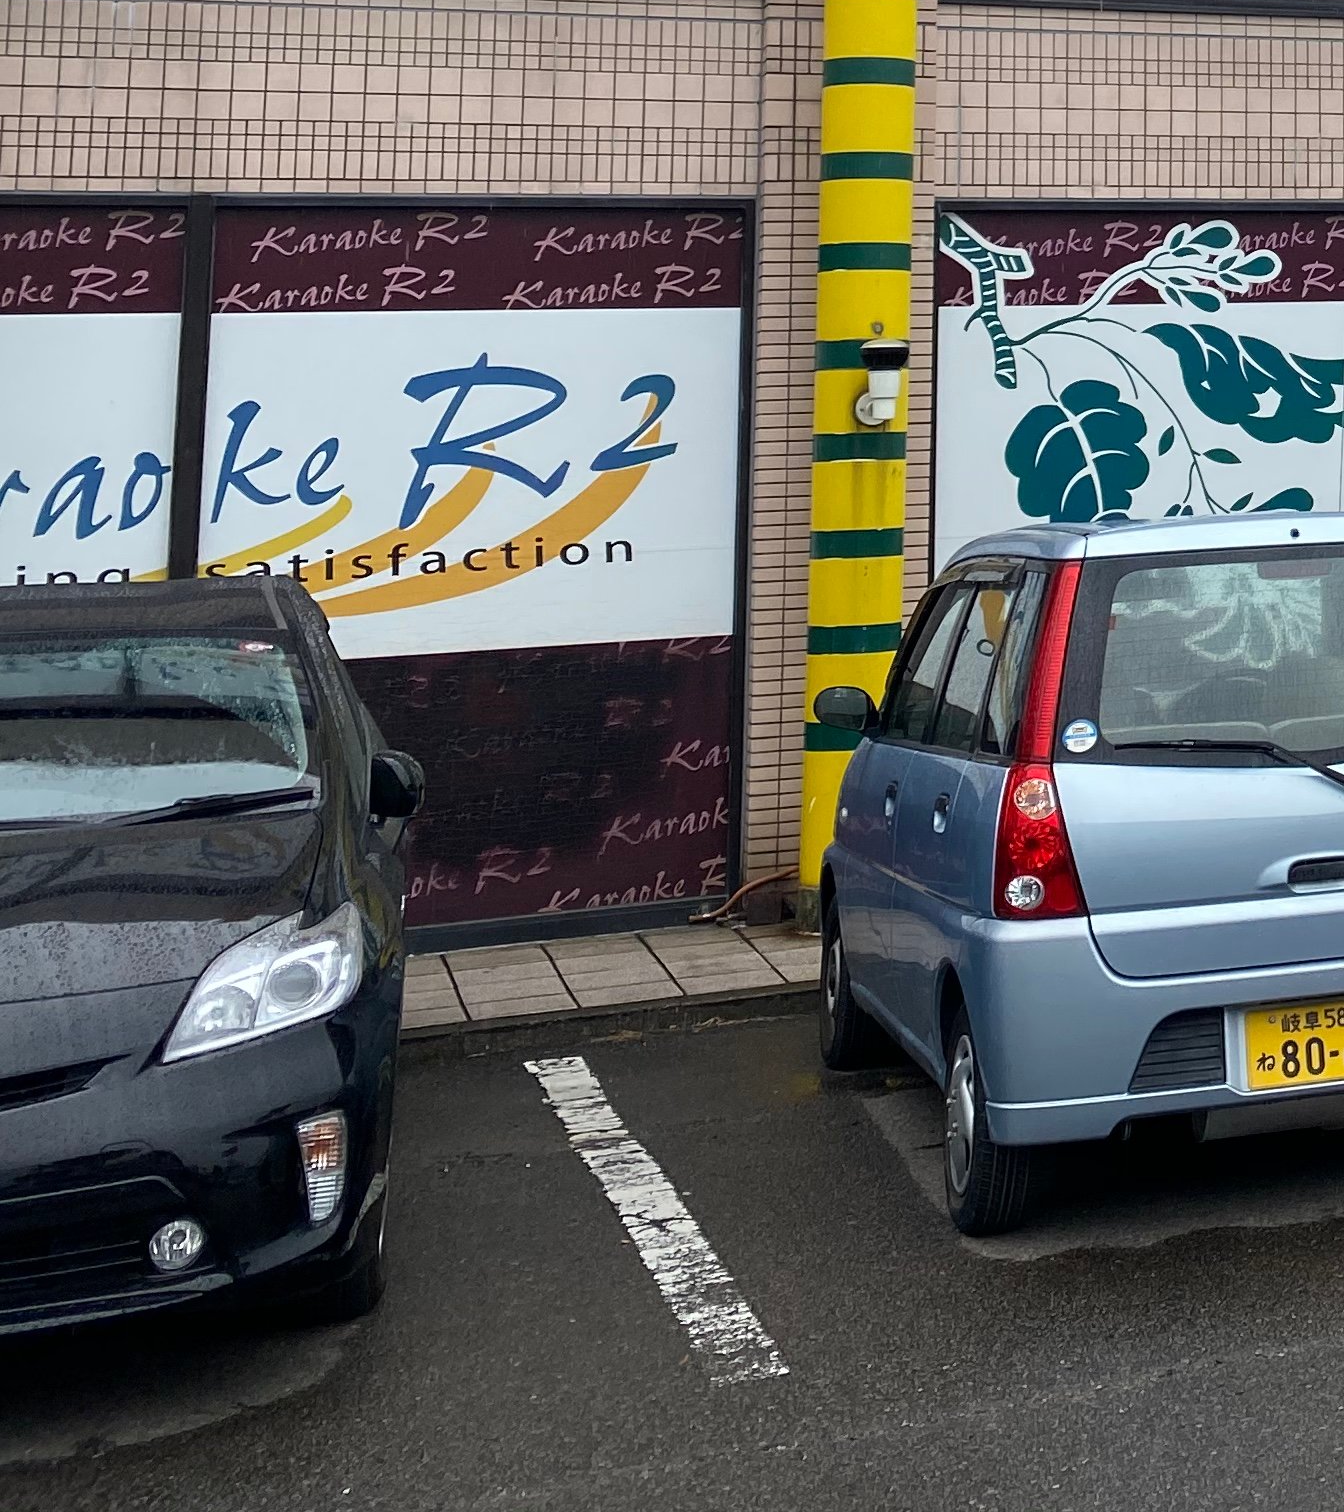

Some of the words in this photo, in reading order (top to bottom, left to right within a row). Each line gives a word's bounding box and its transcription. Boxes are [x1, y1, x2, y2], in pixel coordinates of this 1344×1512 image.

[1, 217, 92, 251] raoke
[106, 209, 186, 251] R2
[251, 219, 402, 263] Karaoke
[415, 211, 489, 251] R2
[533, 219, 673, 262] Karaoke
[1103, 219, 1163, 258] R2
[68, 264, 150, 310] R2
[215, 274, 368, 313] Karaoke
[381, 263, 456, 307] R2
[502, 272, 641, 310] Karaoke
[654, 263, 722, 304] R2
[402, 353, 679, 530] R2
[598, 796, 728, 862] Karaok
[1256, 1052, 1276, 1072] ね
